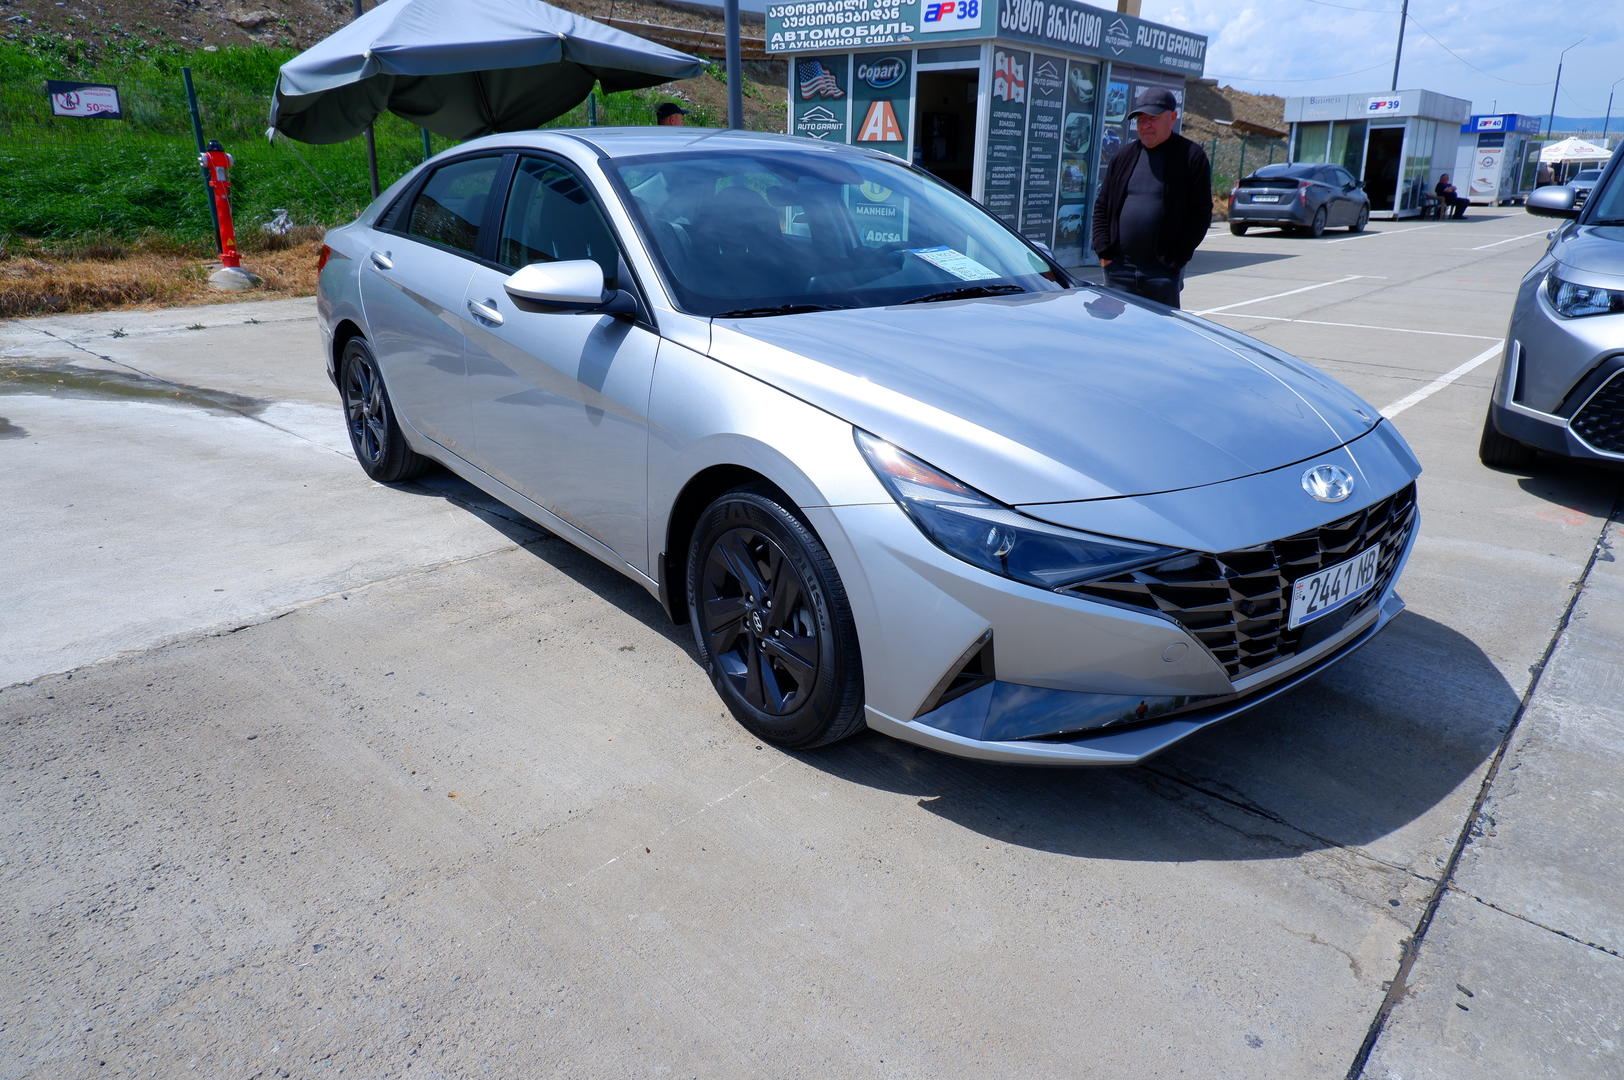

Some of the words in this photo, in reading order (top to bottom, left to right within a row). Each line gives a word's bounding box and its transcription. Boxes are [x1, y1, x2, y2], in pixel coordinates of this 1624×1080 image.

[957, 0, 978, 19] 38
[771, 22, 914, 43] АВТОМОБИЛЬ
[1046, 4, 1102, 48] გრანიტი
[771, 43, 785, 51] ИЗ
[789, 38, 861, 50] АУКЦИОНОВ
[865, 35, 894, 44] США
[1136, 25, 1166, 50] AUTO
[1166, 33, 1205, 59] GRANIT
[857, 62, 900, 83] Copart
[87, 103, 99, 112] 50
[1387, 100, 1399, 109] 39
[798, 123, 816, 131] AUTO
[816, 123, 844, 131] GRANIT
[856, 206, 896, 217] MANHEIM
[1307, 562, 1353, 613] 2441
